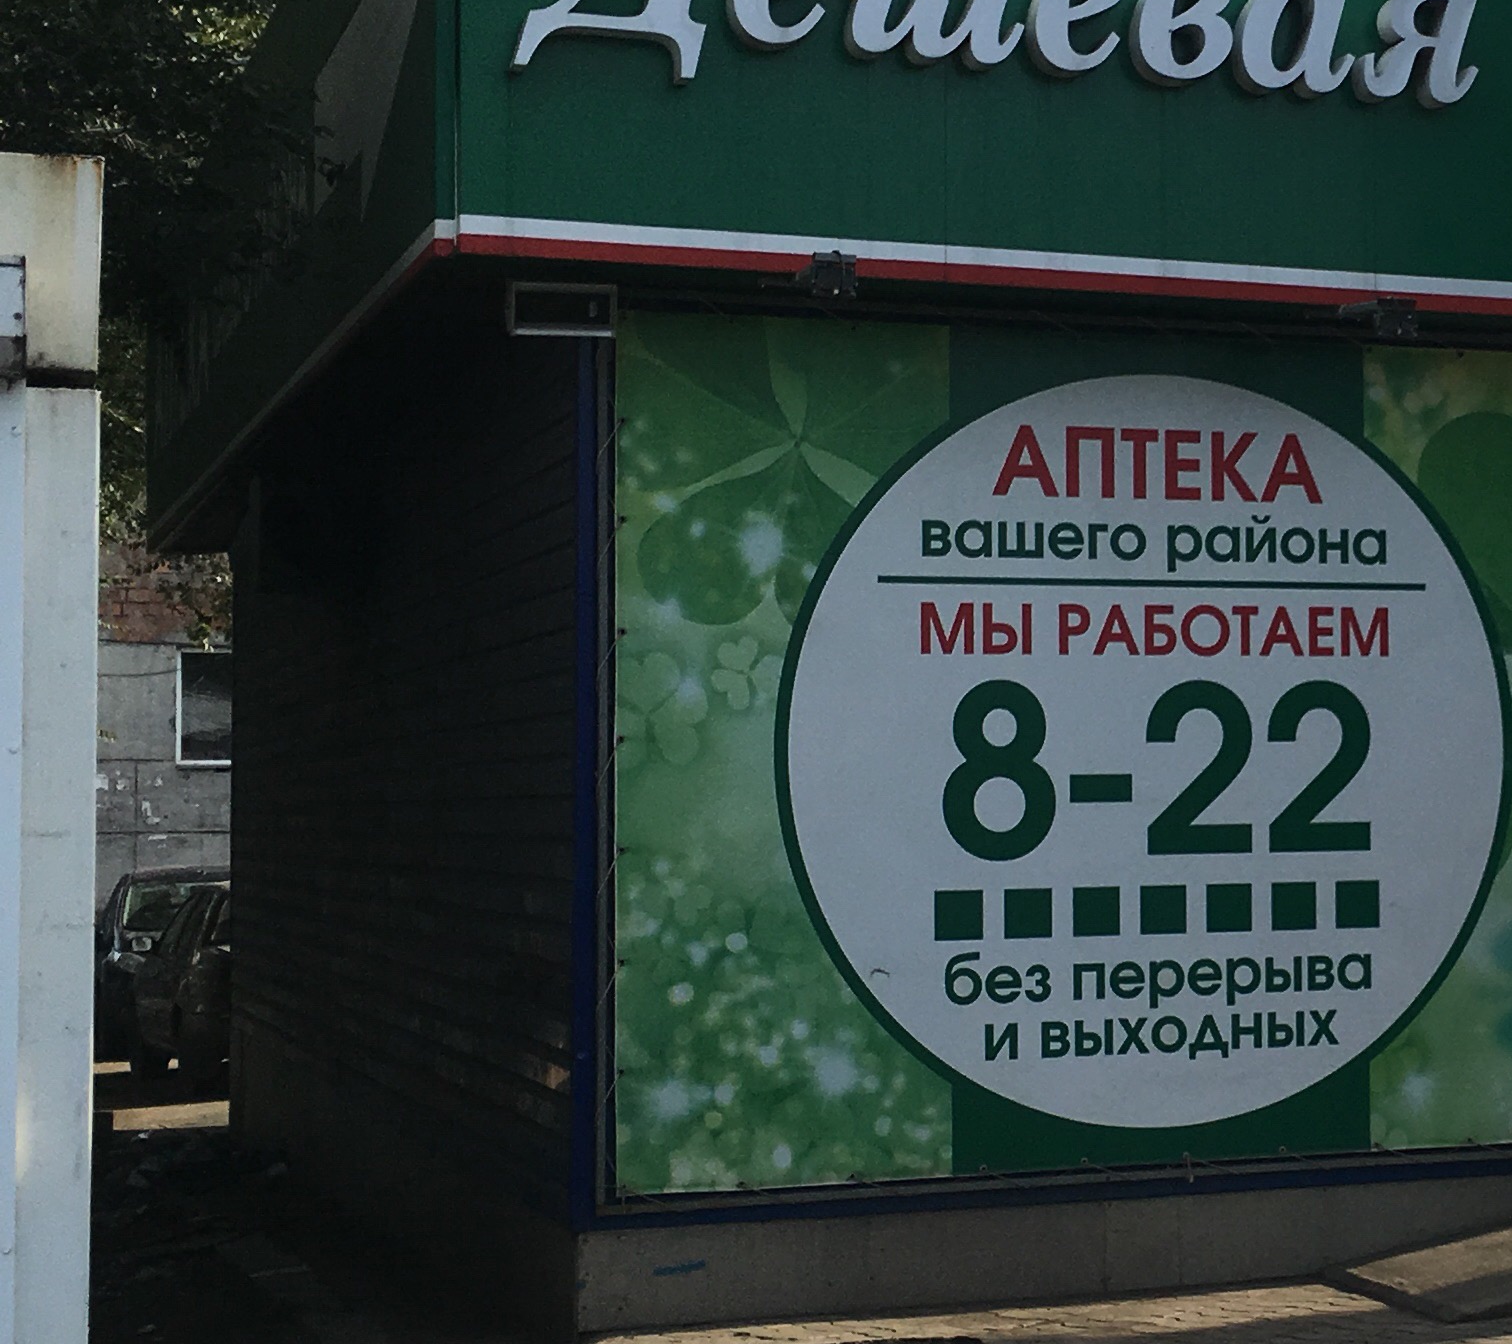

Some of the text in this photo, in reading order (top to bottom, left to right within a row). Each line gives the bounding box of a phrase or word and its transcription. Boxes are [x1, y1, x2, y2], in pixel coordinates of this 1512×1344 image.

[992, 424, 1323, 504] АПТЕКА
[922, 515, 1387, 572] вашего района
[920, 602, 1390, 657] МЫ РАБОТАЕМ
[941, 679, 1372, 862] 8-22
[944, 951, 1373, 1008] без перерыва
[984, 1009, 1339, 1061] и выходных
